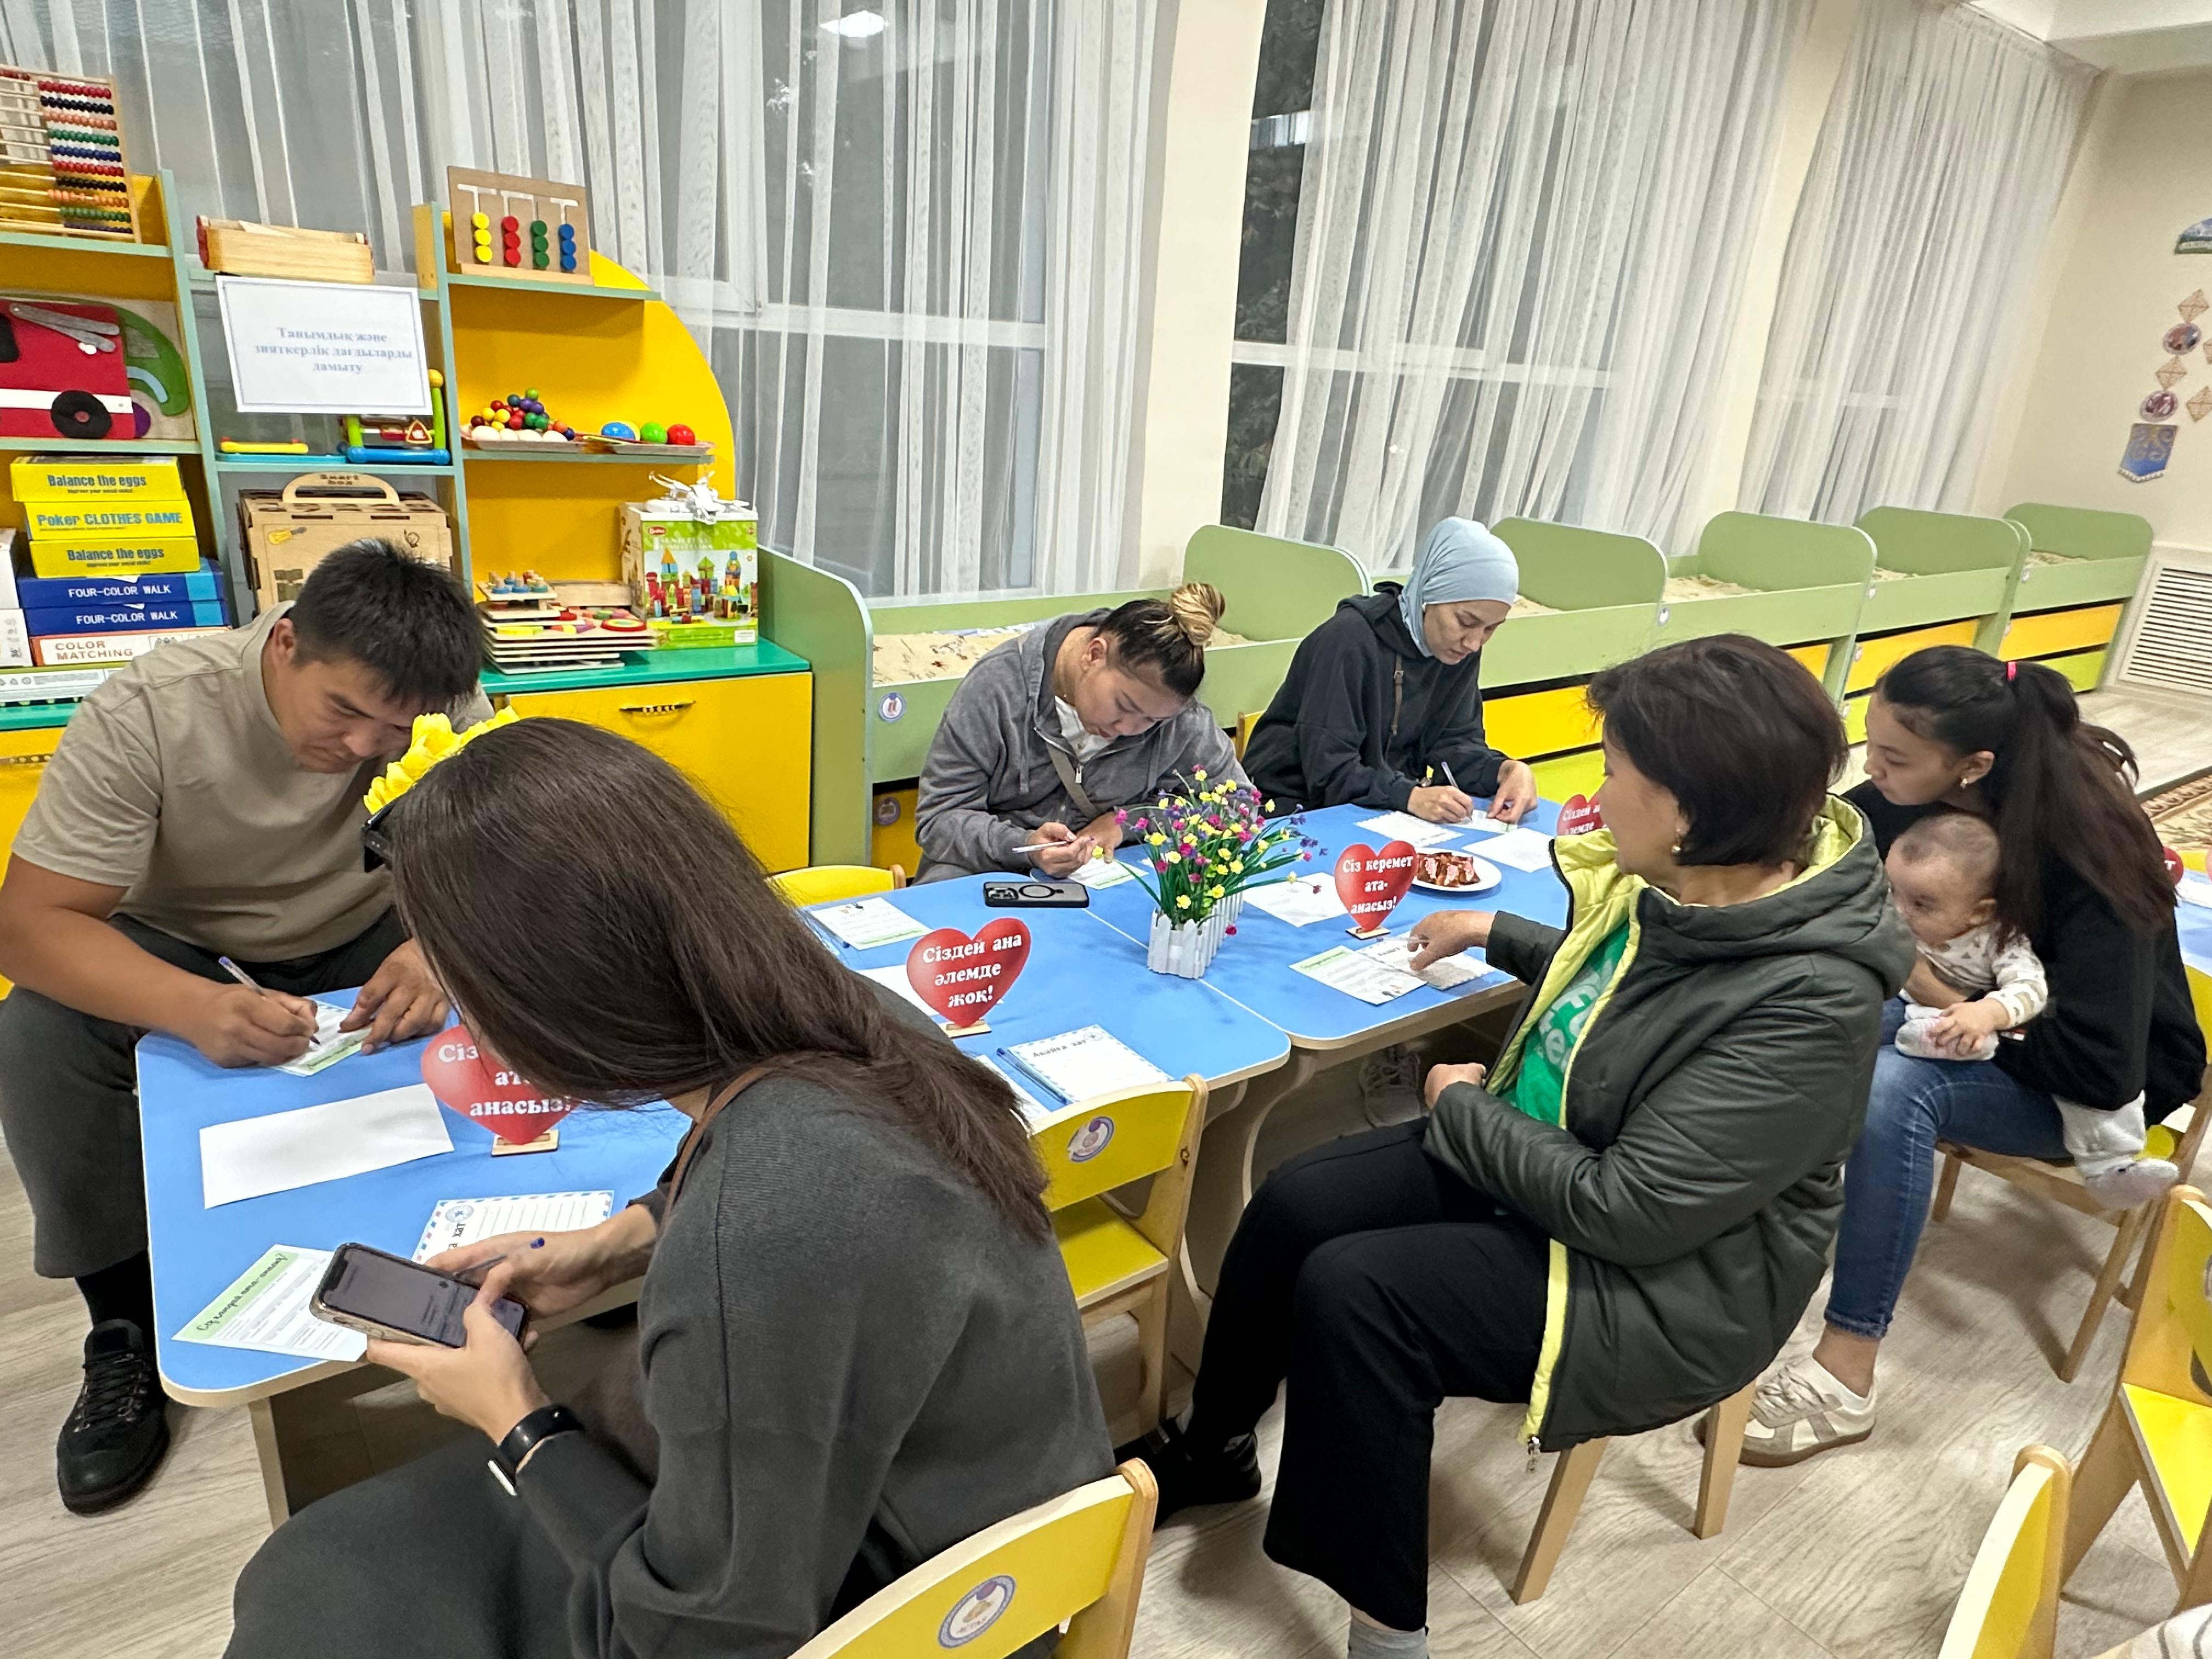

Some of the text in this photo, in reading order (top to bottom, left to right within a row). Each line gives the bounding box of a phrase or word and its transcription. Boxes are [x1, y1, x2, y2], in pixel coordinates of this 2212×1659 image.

[278, 328, 387, 343] Танымдық және
[255, 344, 329, 358] зияткерлік
[313, 363, 362, 374] дамыту
[47, 475, 146, 487] Balance the eggs
[37, 512, 182, 526] Poker CLOTHES GAME
[67, 549, 164, 560] Balance the eggs
[69, 585, 171, 597] FOUR-COLOR WALK
[76, 611, 177, 624] FOUR-COLOR WALK
[55, 641, 105, 650] COLOR
[56, 649, 133, 660] MATCHING
[1342, 856, 1413, 873] Сіз керемет
[1364, 880, 1388, 892] ата-
[1351, 895, 1397, 914] анасыз!
[923, 934, 1023, 963] Сіздей ана
[935, 963, 1001, 986] әлемде
[947, 985, 994, 1008] жоқ!
[452, 1222, 466, 1238] хат
